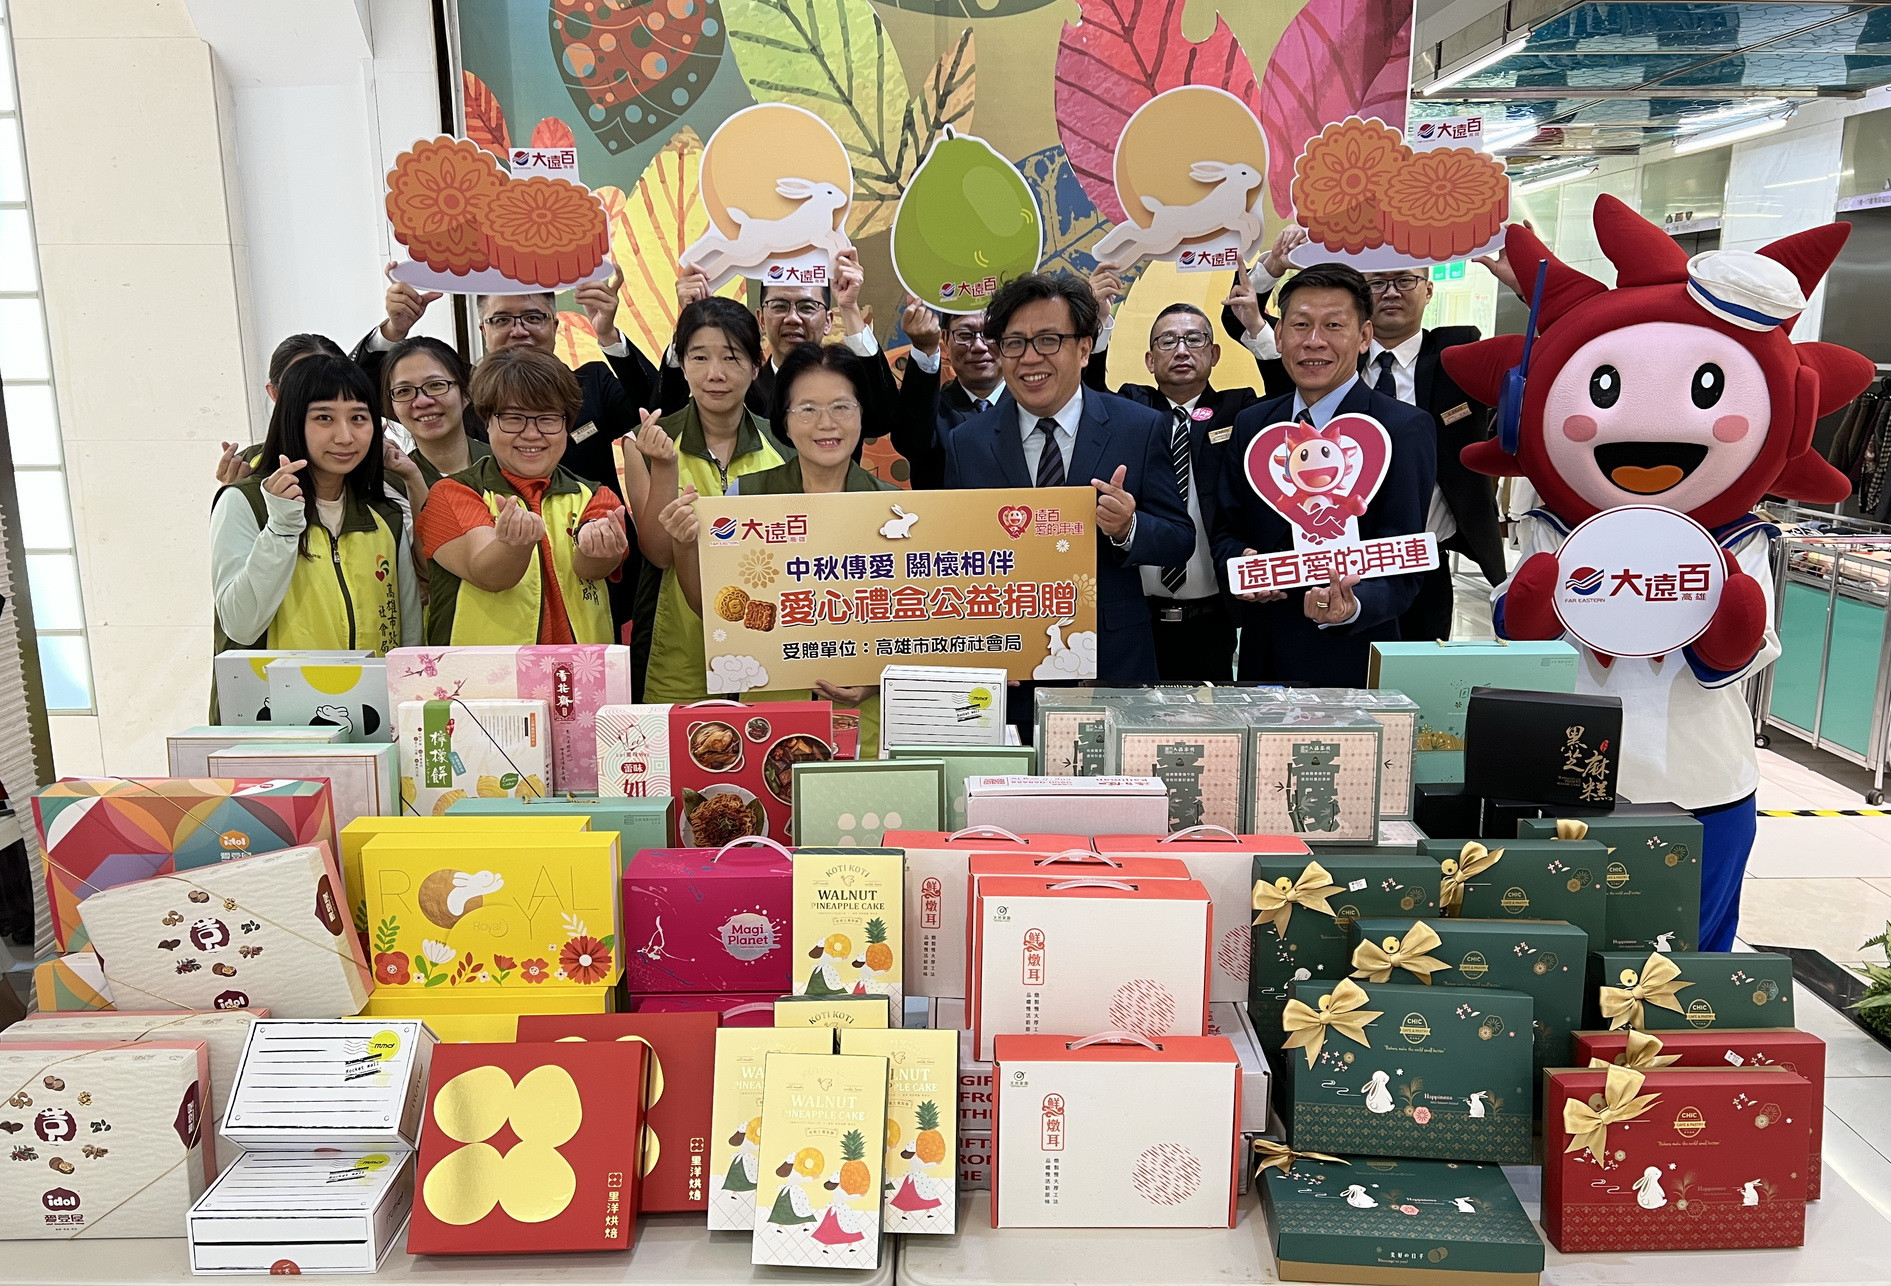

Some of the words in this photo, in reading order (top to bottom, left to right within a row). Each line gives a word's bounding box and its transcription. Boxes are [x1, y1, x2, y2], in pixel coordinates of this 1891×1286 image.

[1437, 117, 1482, 139] 大遠百
[532, 150, 575, 169] 大遠百
[1197, 247, 1238, 267] 大遠百
[786, 265, 826, 283] 大遠百
[957, 276, 996, 297] 大遠百
[1035, 509, 1060, 522] 遠百
[741, 514, 807, 543] 大遠百
[786, 553, 895, 582] 中秋傳愛
[906, 550, 1015, 579] 關懷相伴
[1237, 538, 1430, 590] 遠百愛的串連
[1609, 563, 1711, 602] 大遠百
[1681, 593, 1706, 601] 高雄
[778, 582, 1077, 628] 愛心禮盒公益捐贈
[386, 583, 399, 648] 高雄市政
[223, 835, 246, 846] idol
[825, 864, 847, 878] KOTI
[849, 864, 870, 878] KOTI
[818, 889, 878, 901] WALNUT
[811, 902, 860, 910] PINEAPPLE
[861, 902, 885, 910] CAKE
[732, 924, 764, 936] Magi
[728, 936, 769, 945] Planet
[1027, 931, 1042, 982] 鮮燉耳
[1691, 1003, 1709, 1011] CHIC
[808, 1011, 830, 1025] KOTI
[833, 1011, 855, 1025] KOTI
[913, 1083, 937, 1092] CAKE
[791, 1094, 858, 1109] WALNUT
[960, 1092, 993, 1103] FRO
[783, 1109, 837, 1120] PINEAPPLE
[839, 1111, 865, 1121] CAKE
[960, 1108, 992, 1119] TH
[1046, 1097, 1061, 1147] 鮮燉耳
[689, 1156, 702, 1201] 里洋烘焙
[960, 1170, 982, 1181] HE
[47, 1194, 76, 1207] idol
[605, 1191, 619, 1239] 里洋烘焙
